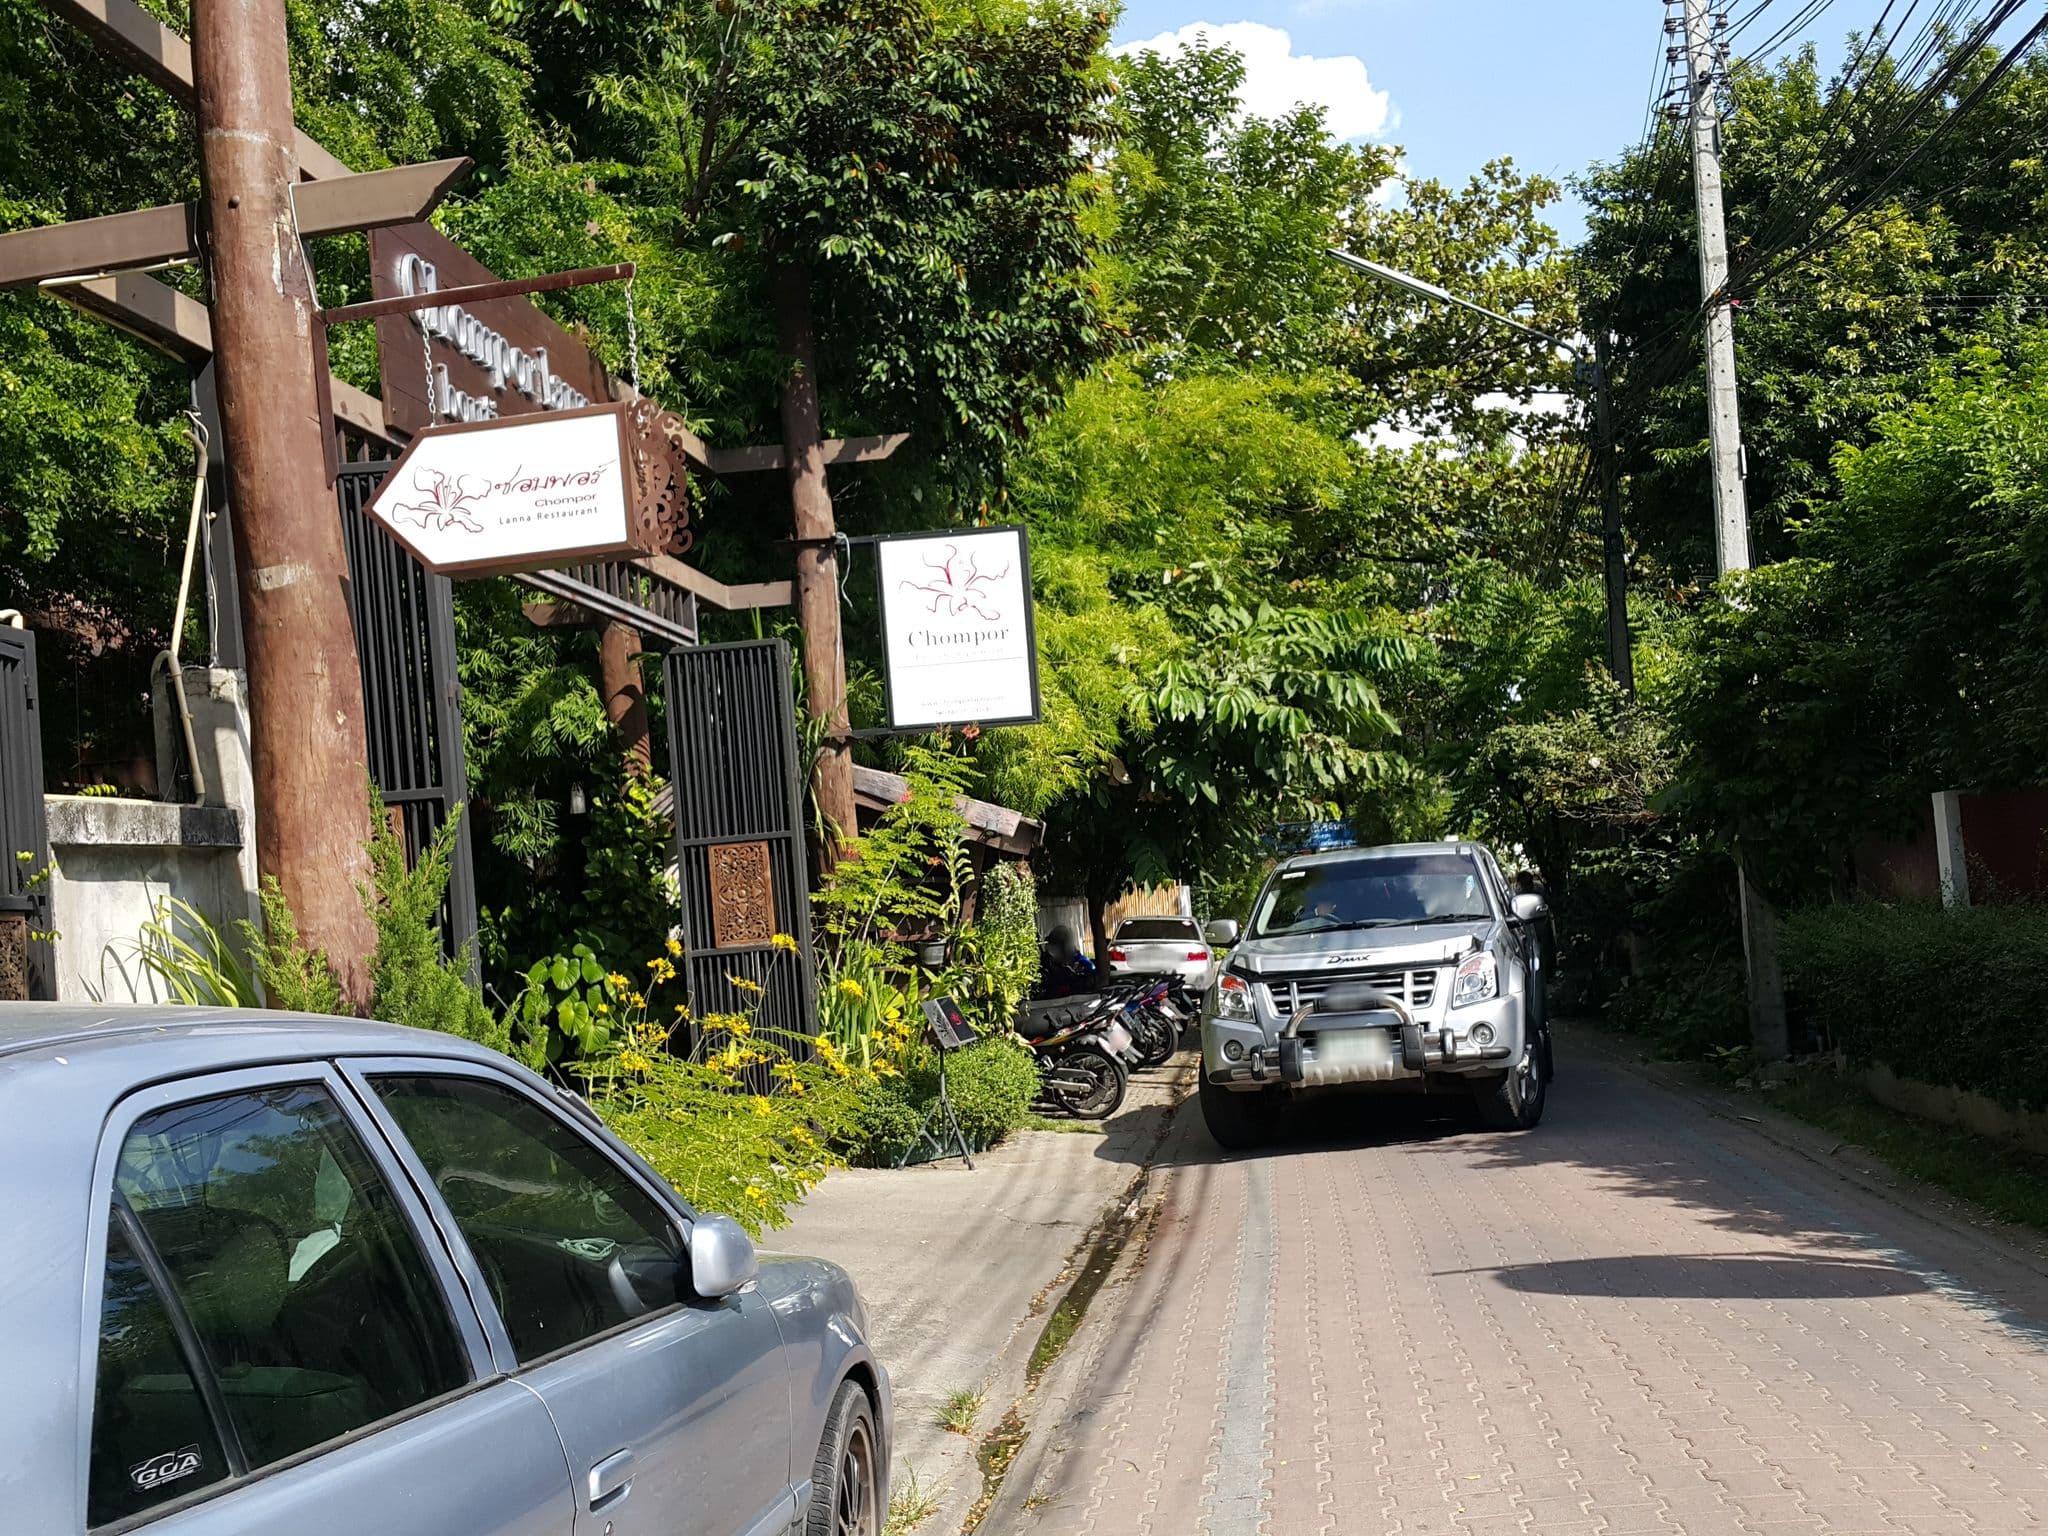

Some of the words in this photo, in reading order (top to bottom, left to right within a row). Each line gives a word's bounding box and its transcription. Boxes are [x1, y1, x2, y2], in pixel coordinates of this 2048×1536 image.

[534, 493, 597, 508] Chompor
[499, 515, 532, 525] Lanna
[537, 506, 598, 520] Restaurant
[908, 628, 1009, 648] Chompor
